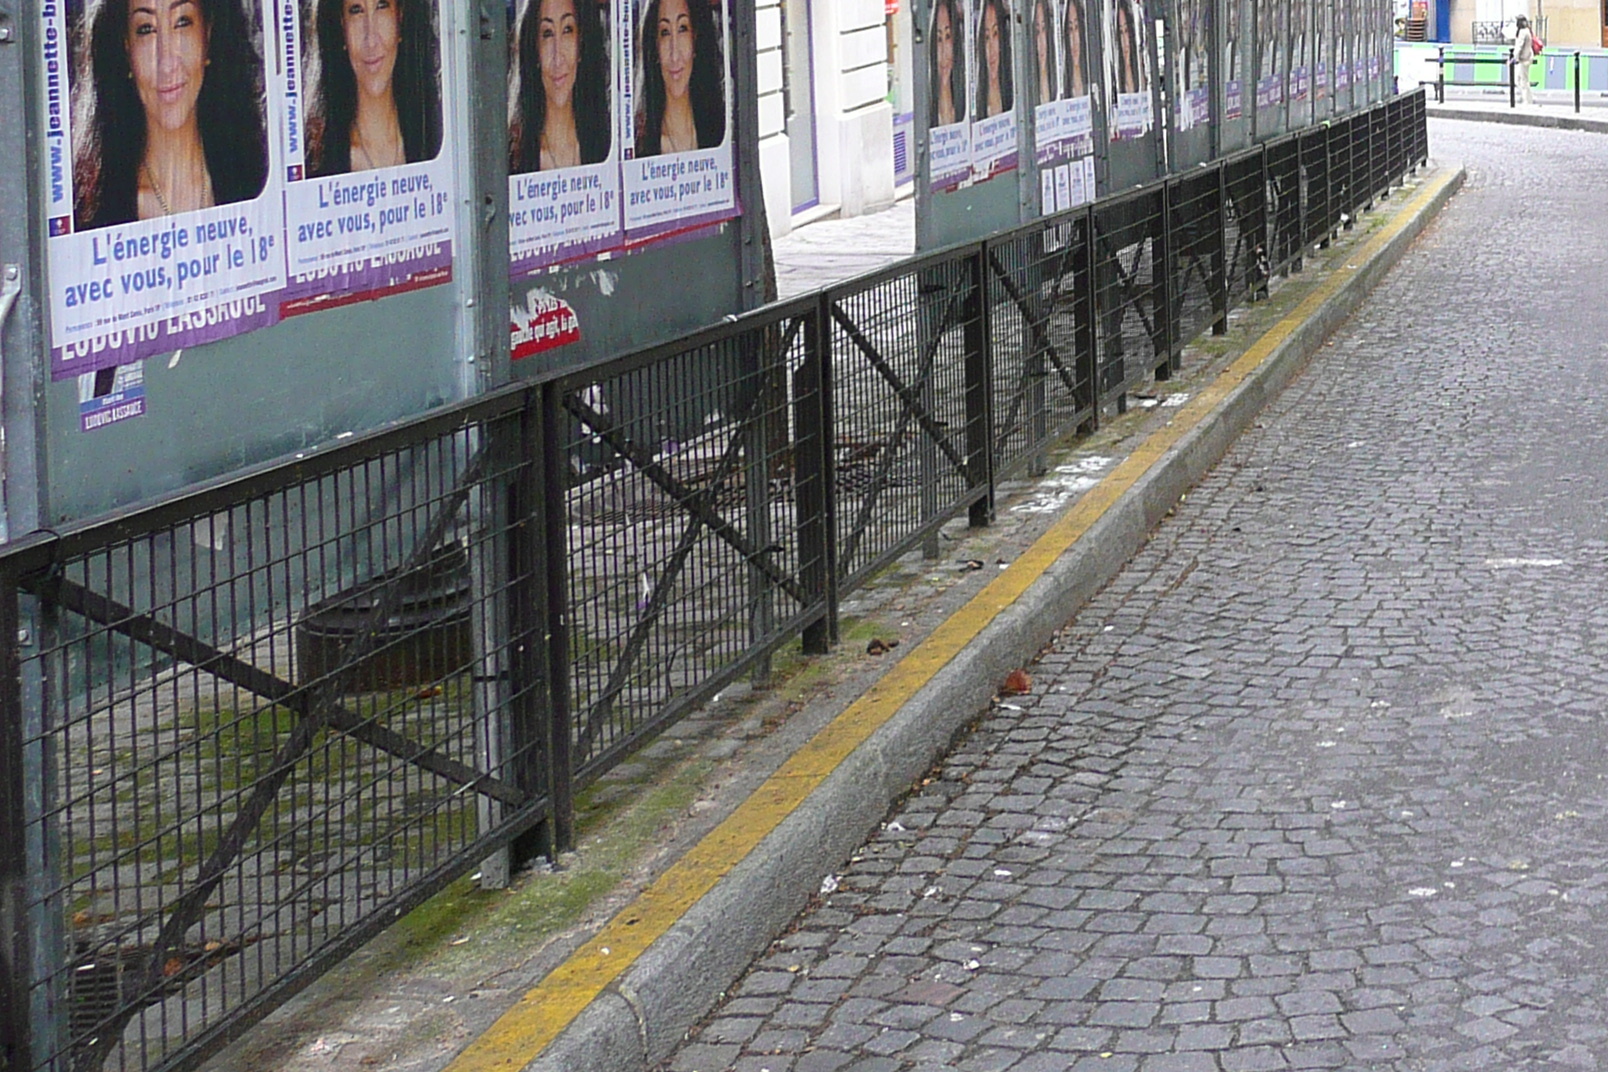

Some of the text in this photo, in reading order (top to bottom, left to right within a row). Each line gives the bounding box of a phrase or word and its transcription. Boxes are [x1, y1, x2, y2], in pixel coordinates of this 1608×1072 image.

[642, 156, 685, 181] L'énergie
[319, 174, 432, 208] L'énergie neuve,
[518, 175, 602, 200] L'énergie neuve,
[630, 190, 650, 206] avec
[653, 185, 677, 201] vous,
[679, 180, 700, 201] pour
[704, 175, 711, 191] le
[298, 219, 332, 242] avec
[338, 212, 375, 234] vous,
[380, 205, 409, 234] pour
[414, 197, 425, 219] le
[531, 205, 557, 223] vous,
[561, 200, 584, 223] pour
[586, 194, 595, 212] le
[92, 216, 253, 265] L'énergie neuve,
[65, 278, 113, 307] avec
[121, 265, 172, 294] vous,
[177, 254, 219, 290] pour
[228, 244, 244, 269] le
